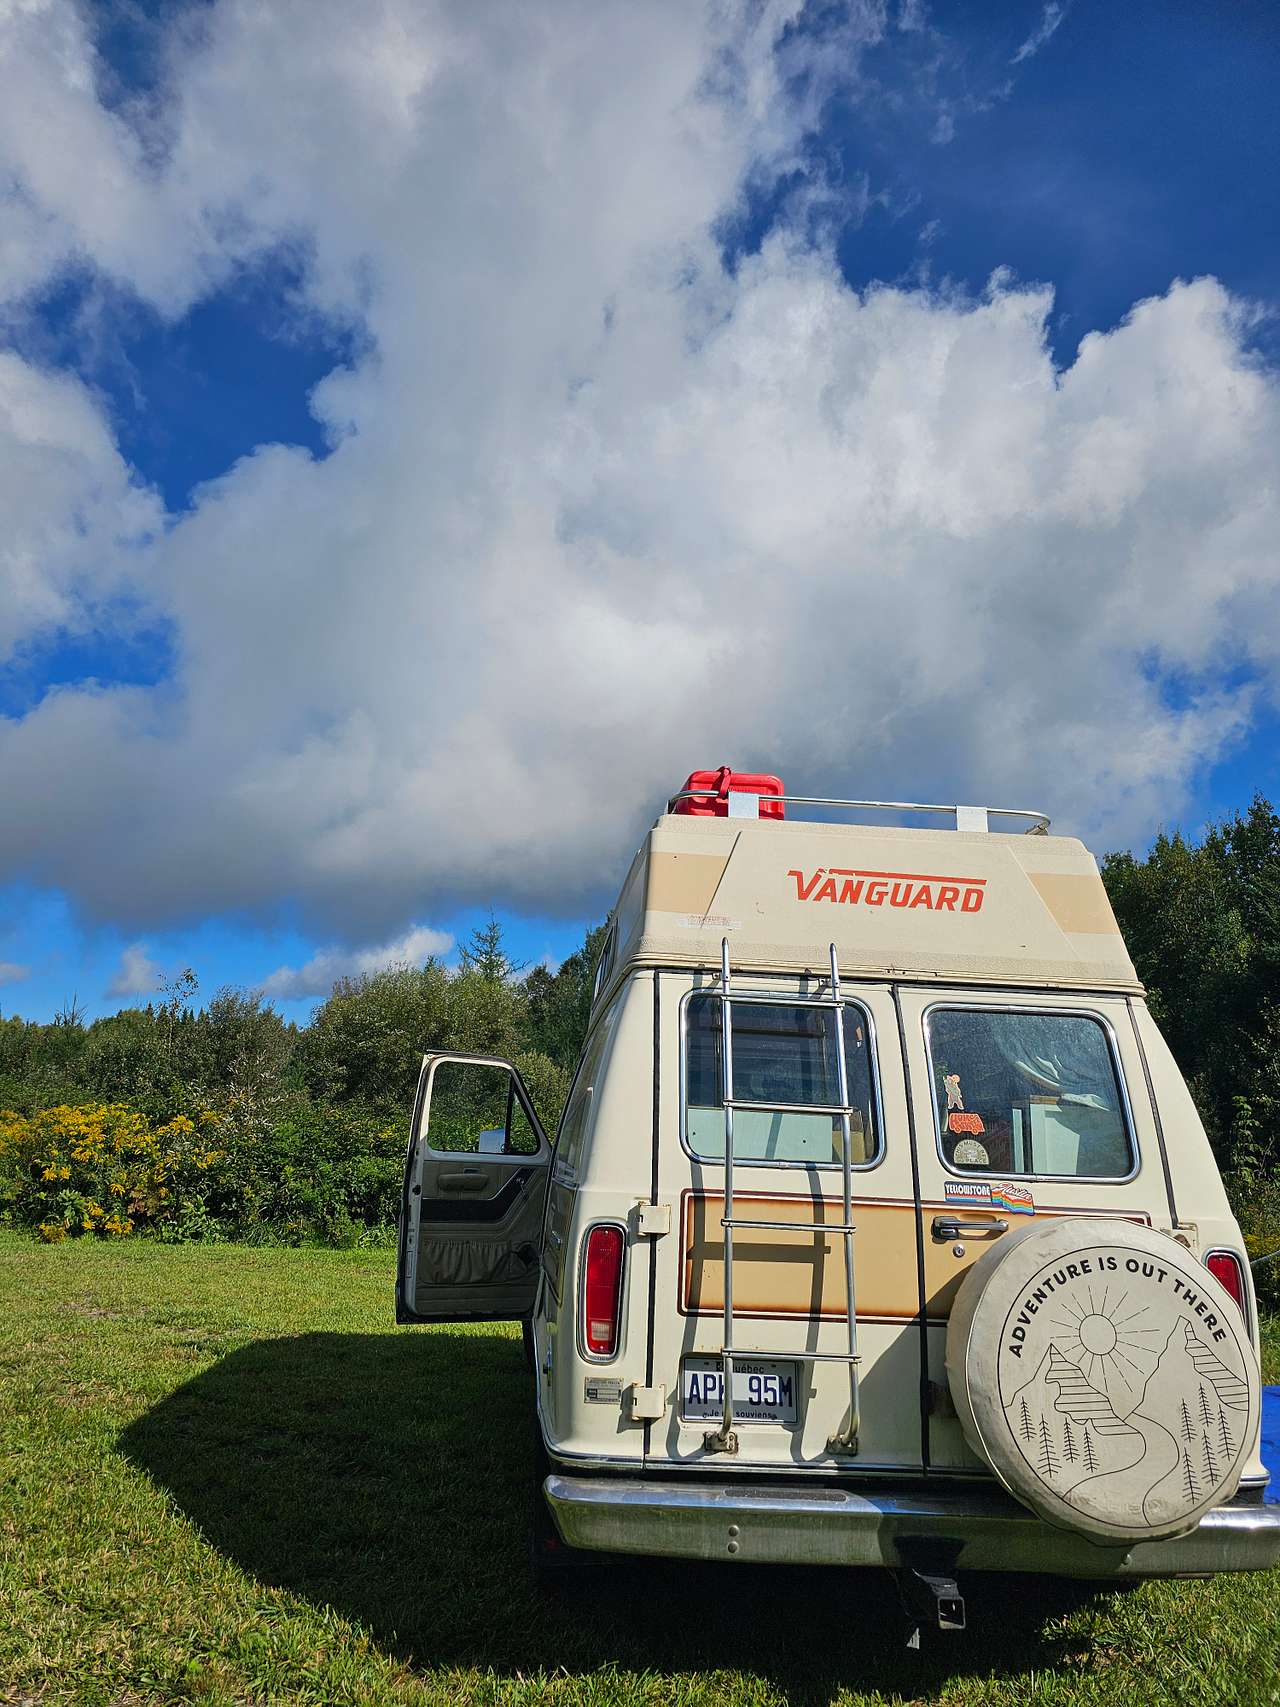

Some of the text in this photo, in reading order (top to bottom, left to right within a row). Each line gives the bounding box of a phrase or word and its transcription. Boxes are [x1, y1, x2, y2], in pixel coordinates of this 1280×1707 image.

[787, 868, 987, 912] VANGUARD
[945, 1184, 991, 1196] YELLOWSTONE
[1009, 1256, 1227, 1358] ADVENTURE IS OUT THERE
[733, 1363, 764, 1374] uébec
[748, 1375, 793, 1408] 95M
